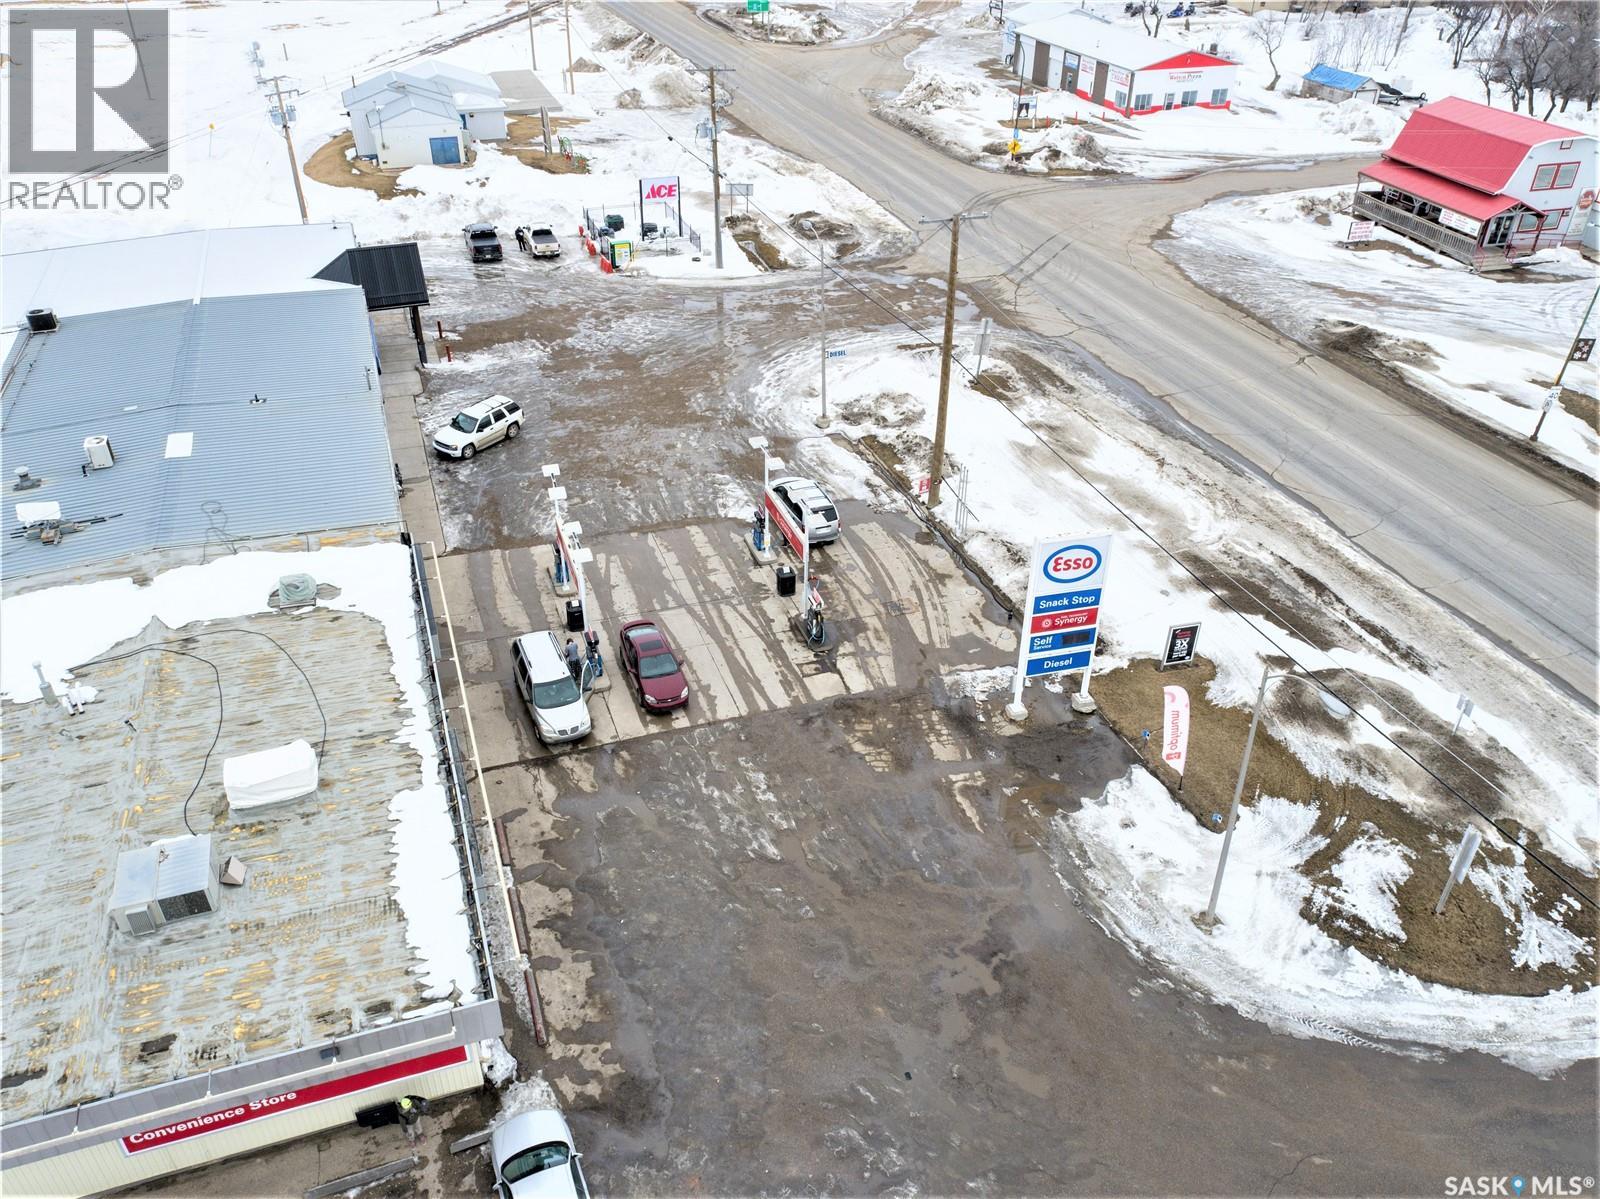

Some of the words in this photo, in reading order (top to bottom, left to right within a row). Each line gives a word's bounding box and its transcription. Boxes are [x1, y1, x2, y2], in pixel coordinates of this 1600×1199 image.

[645, 184, 678, 199] ACE
[829, 350, 847, 358] DIESEL
[1052, 556, 1094, 573] Esso
[1039, 597, 1069, 609] Snack
[1071, 595, 1096, 605] Stop
[1054, 615, 1088, 627] Synergy
[1033, 636, 1053, 647] Self
[1043, 657, 1073, 669] Diesel
[129, 1106, 245, 1144] Convenience
[249, 1091, 297, 1111] Store
